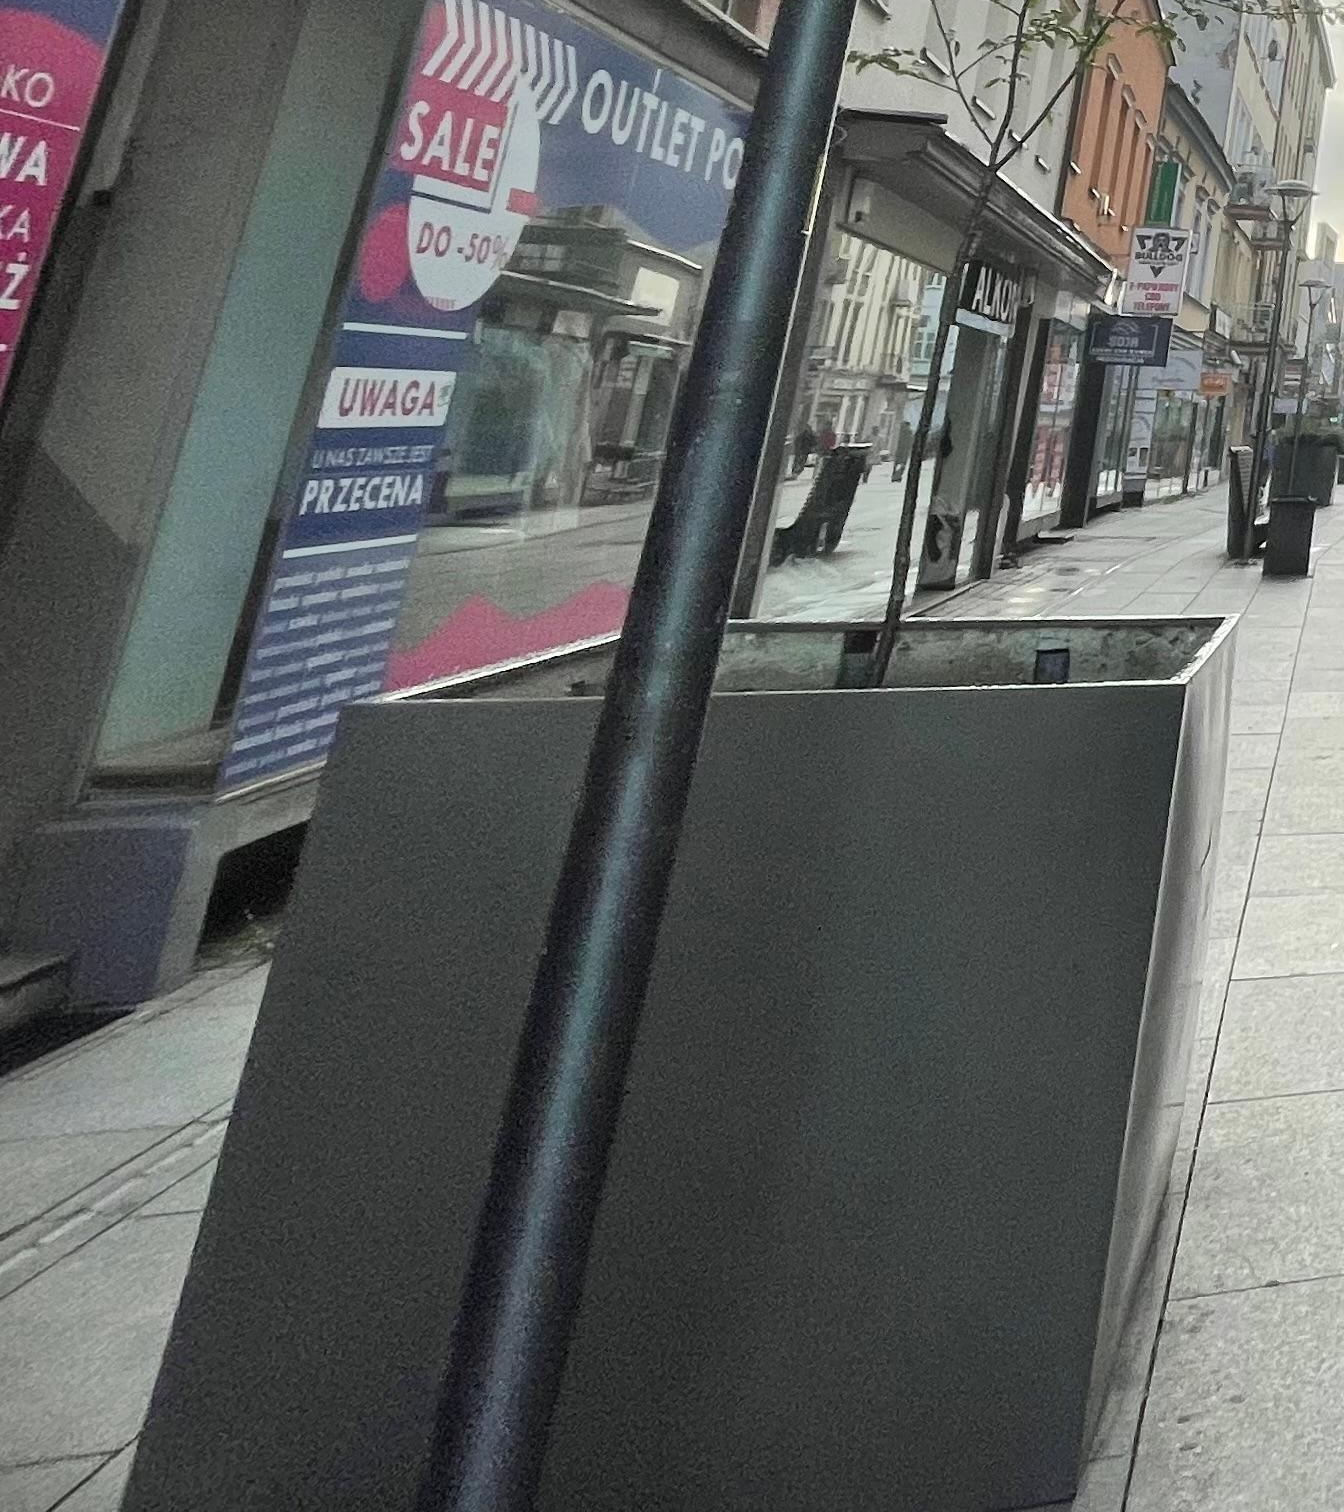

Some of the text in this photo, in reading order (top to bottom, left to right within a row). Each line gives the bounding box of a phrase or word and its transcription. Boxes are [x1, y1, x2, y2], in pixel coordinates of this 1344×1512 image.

[400, 100, 500, 183] SALE
[581, 69, 705, 173] OUTLET
[416, 222, 451, 257] DO
[338, 378, 436, 418] UWAGA
[325, 448, 355, 467] NAS
[299, 474, 423, 516] PRZECENA
